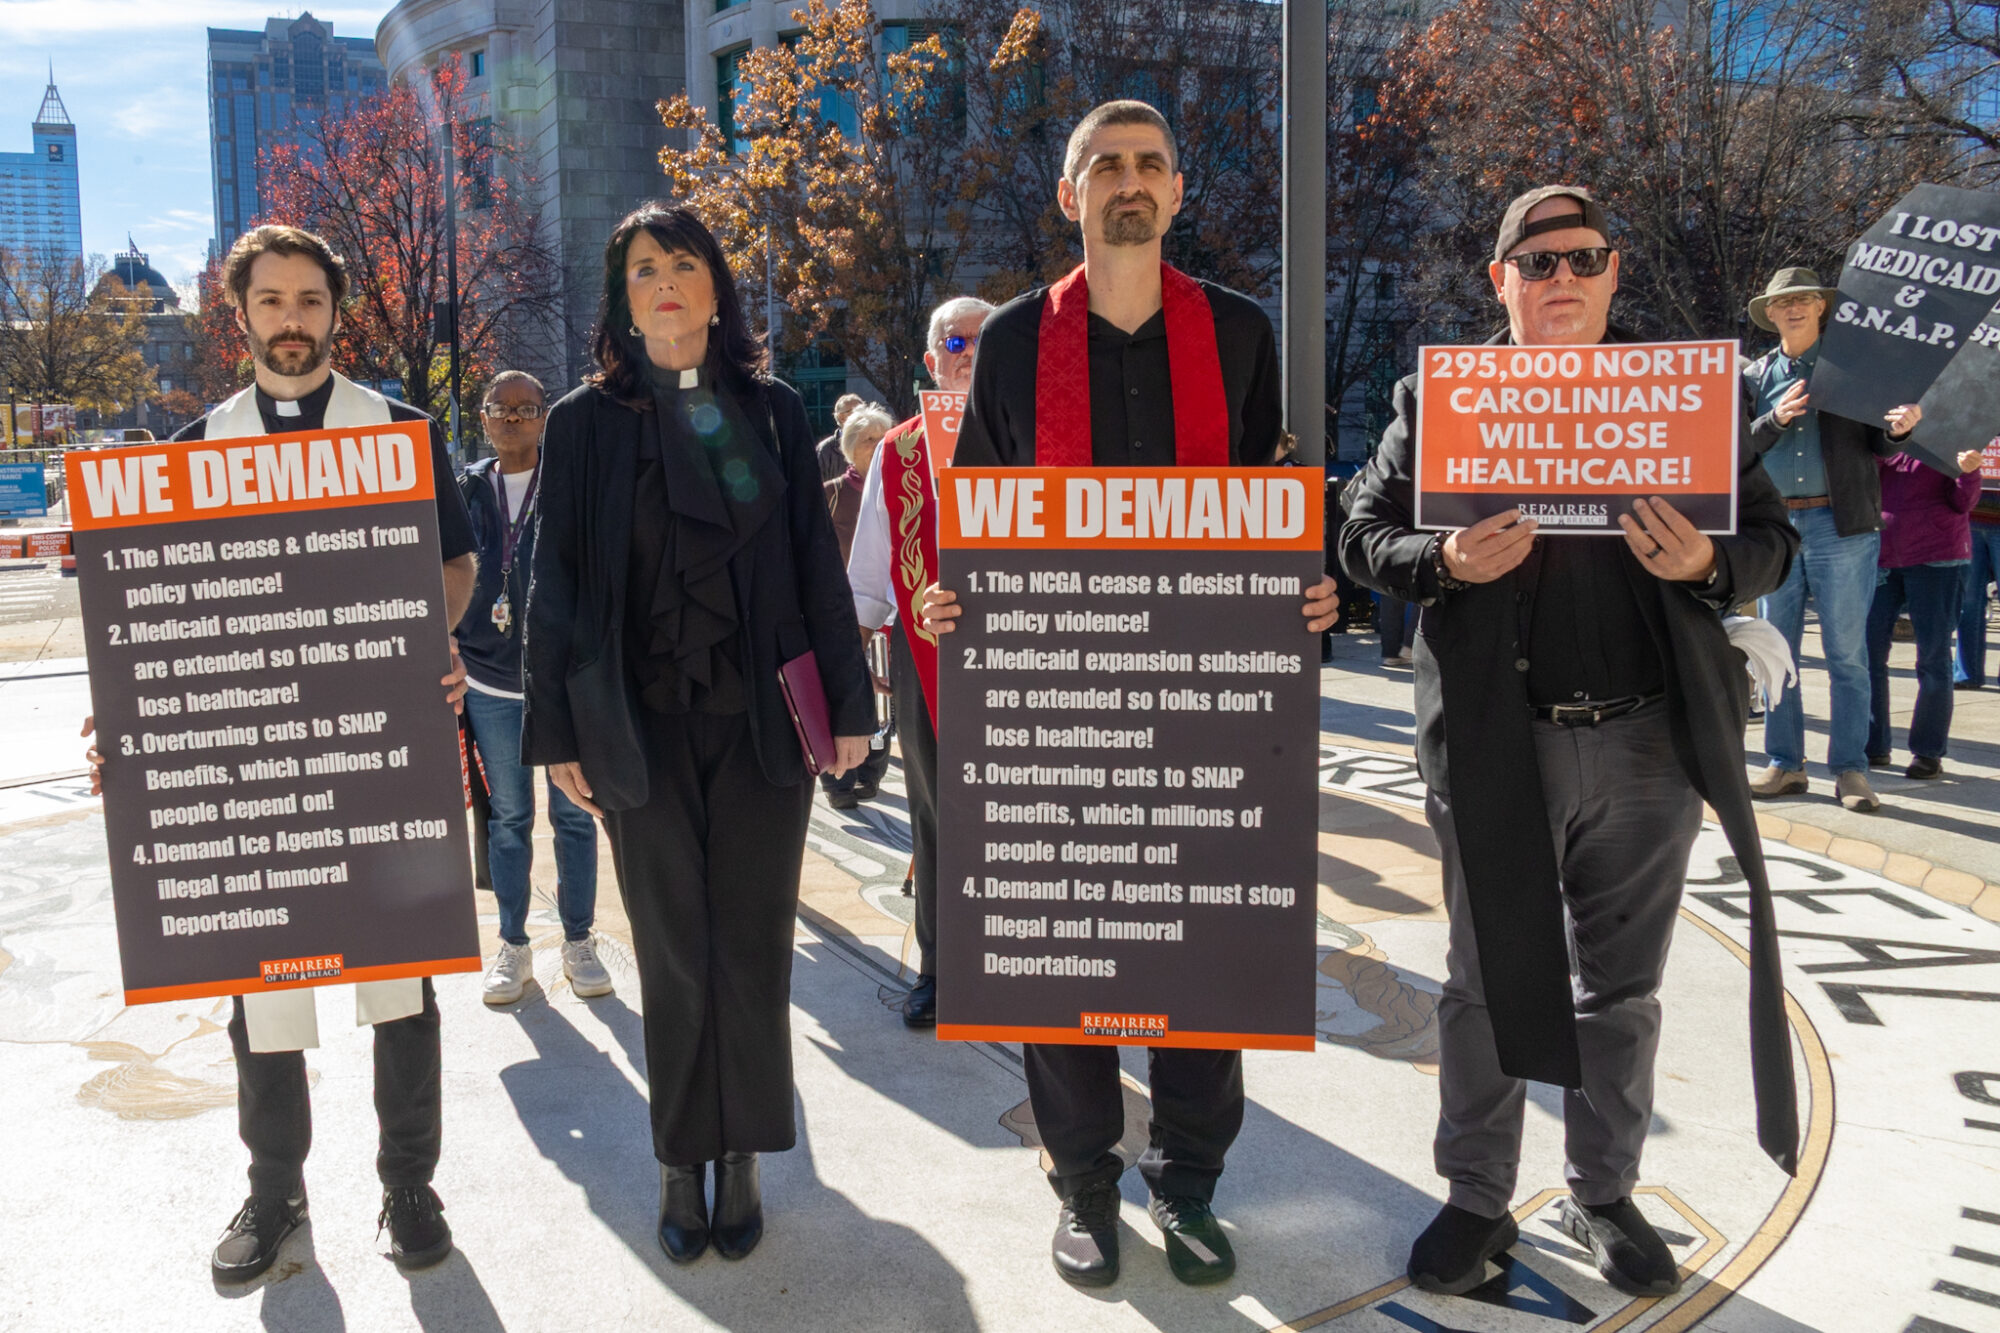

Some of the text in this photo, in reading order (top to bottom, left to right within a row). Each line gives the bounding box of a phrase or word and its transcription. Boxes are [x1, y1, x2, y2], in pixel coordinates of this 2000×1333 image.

[1889, 212, 2000, 251] I LOST
[1849, 242, 2000, 295] MEDICAID
[1894, 285, 1926, 308] &
[1835, 301, 1956, 349] S.N.A.P.
[1968, 322, 2000, 351] SP
[1431, 346, 1726, 383] 295,000 NORTH
[1449, 384, 1702, 414] CAROLINIANS
[1479, 421, 1668, 449] WILL LOSE
[79, 433, 417, 519] WE DEMAND
[1446, 456, 1691, 486] HEALTHCARE!
[954, 478, 1305, 539] WE DEMAND
[1518, 503, 1608, 515] REPAIRERS
[102, 525, 420, 571] 1. The NCGA cease & desist from
[125, 571, 283, 609] policy violence!
[967, 571, 1300, 596] 1. The NCGA cease & desist from
[108, 598, 429, 646] 2. Medicaid expansion subsidies
[986, 609, 1150, 634] policy violence!
[134, 660, 169, 681] are
[172, 648, 266, 677] extended
[269, 648, 295, 668] so
[299, 641, 350, 665] folks
[963, 647, 1301, 674] 2. Medicaid expansion subsidies
[137, 682, 300, 718] lose healthcare!
[985, 689, 1020, 709] are
[1025, 687, 1122, 710] extended
[1127, 691, 1153, 711] so
[1159, 688, 1212, 711] folks
[120, 711, 388, 756] 3. Overturning cuts to SNAP
[985, 724, 1154, 749] lose healthcare!
[145, 745, 409, 791] Benefits, which millions of
[963, 762, 1244, 789] 3. Overturning cuts to SNAP
[149, 789, 335, 830] people depend on!
[985, 801, 1263, 828] Benefits, which millions of
[132, 818, 448, 865] 4. Demand Ice Agents must stop
[984, 840, 1178, 865] people depend on!
[157, 861, 349, 900] illegal and immoral
[962, 876, 1296, 908] 4. Demand Ice Agents must stop
[161, 907, 290, 937] Deportations
[984, 914, 1183, 941] illegal and immoral
[263, 957, 341, 975] REPAIRERS
[265, 968, 341, 982] OF THE BREACH
[984, 952, 1116, 978] Deportations
[1084, 1015, 1165, 1029] REPAIRERS
[1128, 1029, 1164, 1037] BREACH
